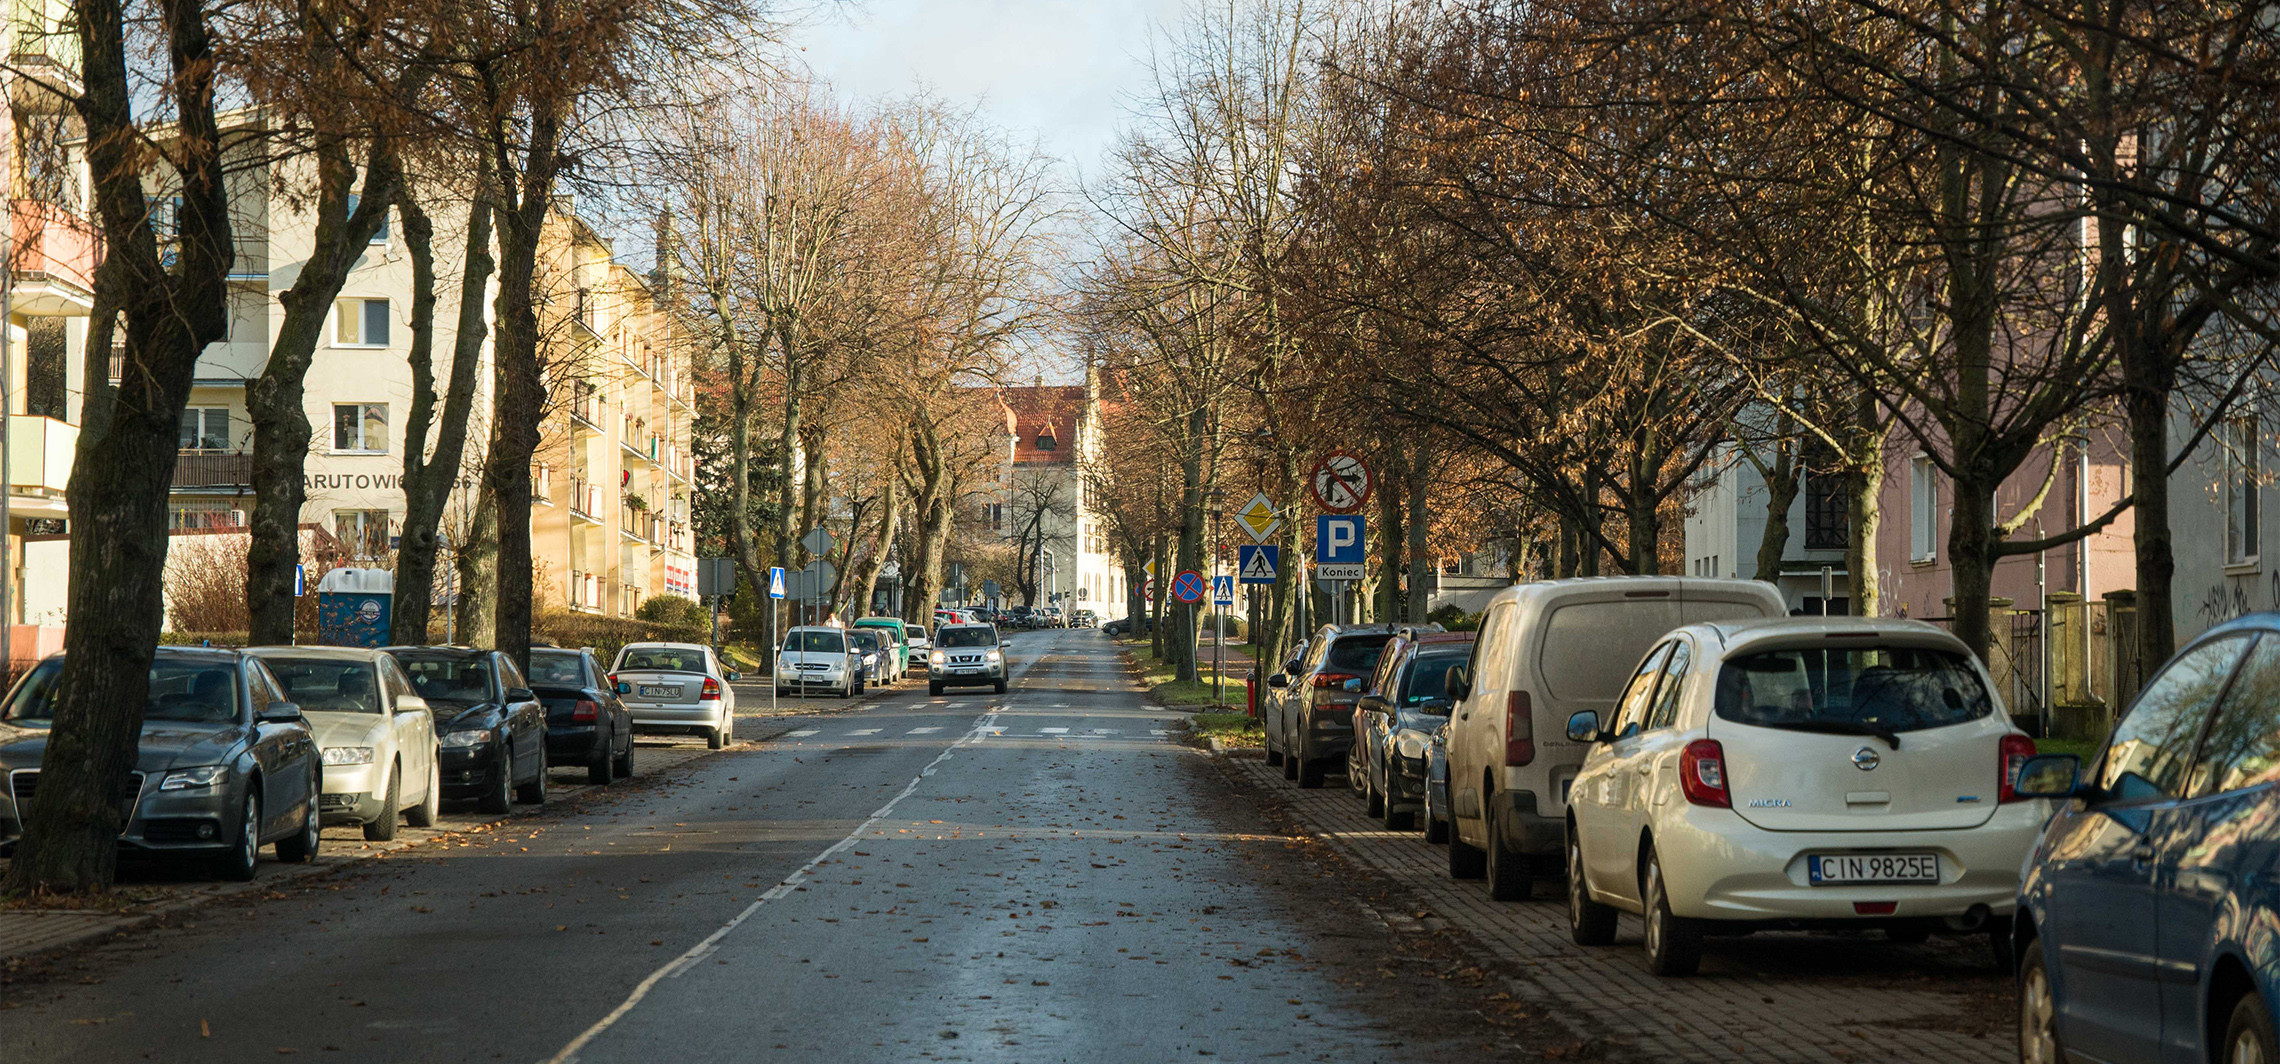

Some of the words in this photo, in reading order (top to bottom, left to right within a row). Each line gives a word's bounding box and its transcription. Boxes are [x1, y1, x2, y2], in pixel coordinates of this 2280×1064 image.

[1328, 520, 1355, 557] P
[1322, 567, 1359, 577] Koniec
[1749, 799, 1792, 808] MICRA
[1822, 858, 1864, 879] CIN
[1869, 857, 1935, 879] 9825E
